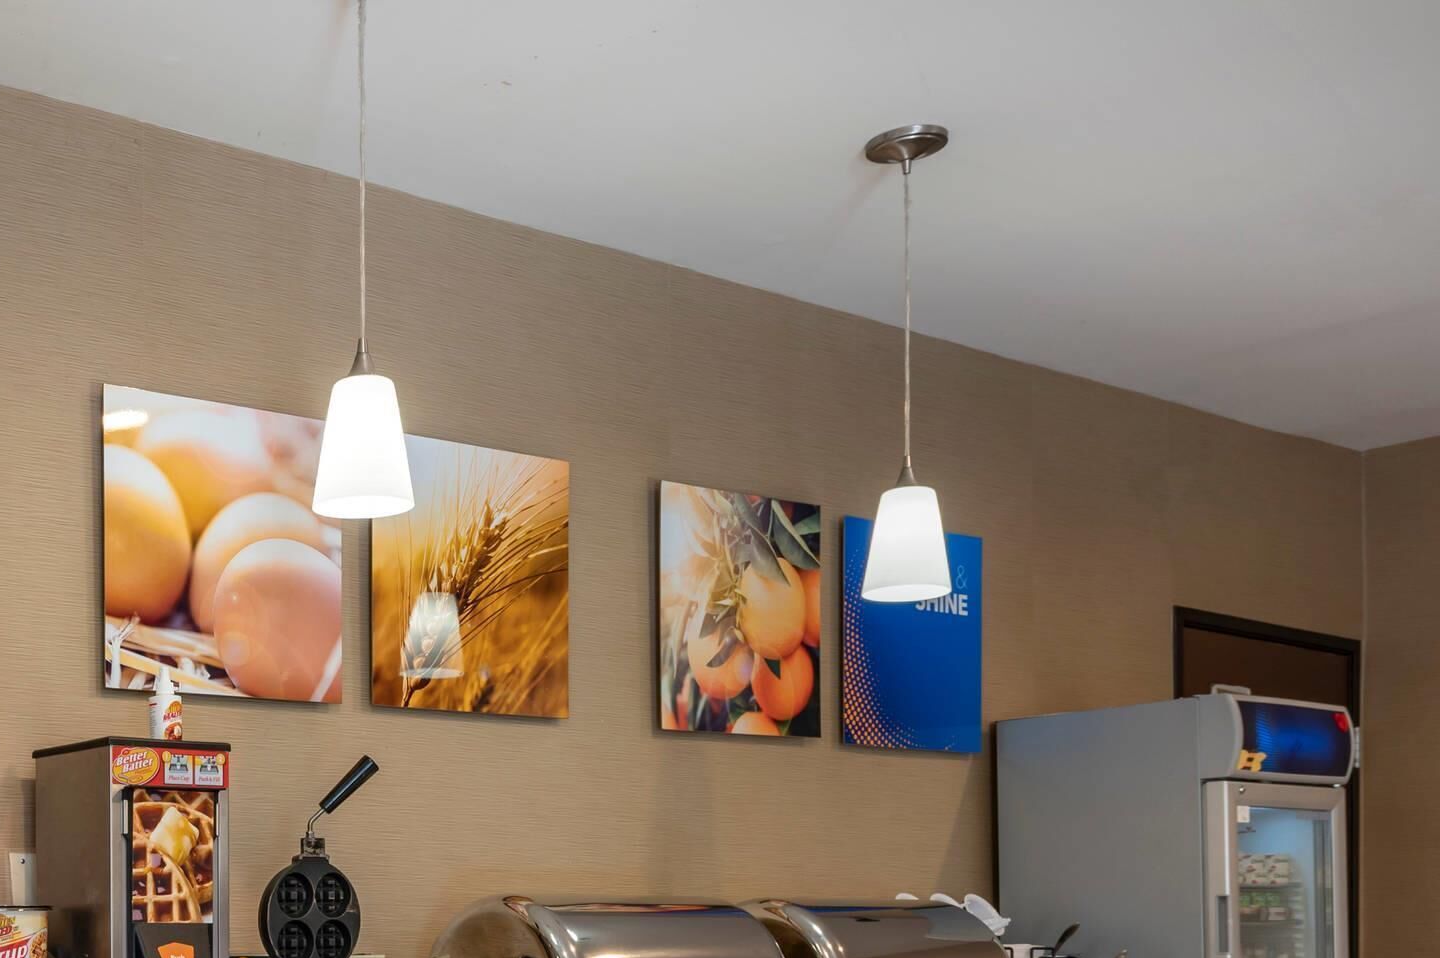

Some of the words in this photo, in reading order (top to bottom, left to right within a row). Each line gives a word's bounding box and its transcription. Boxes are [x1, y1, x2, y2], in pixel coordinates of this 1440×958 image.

[956, 564, 968, 589] &
[116, 751, 148, 766] Better
[122, 758, 153, 773] Batter
